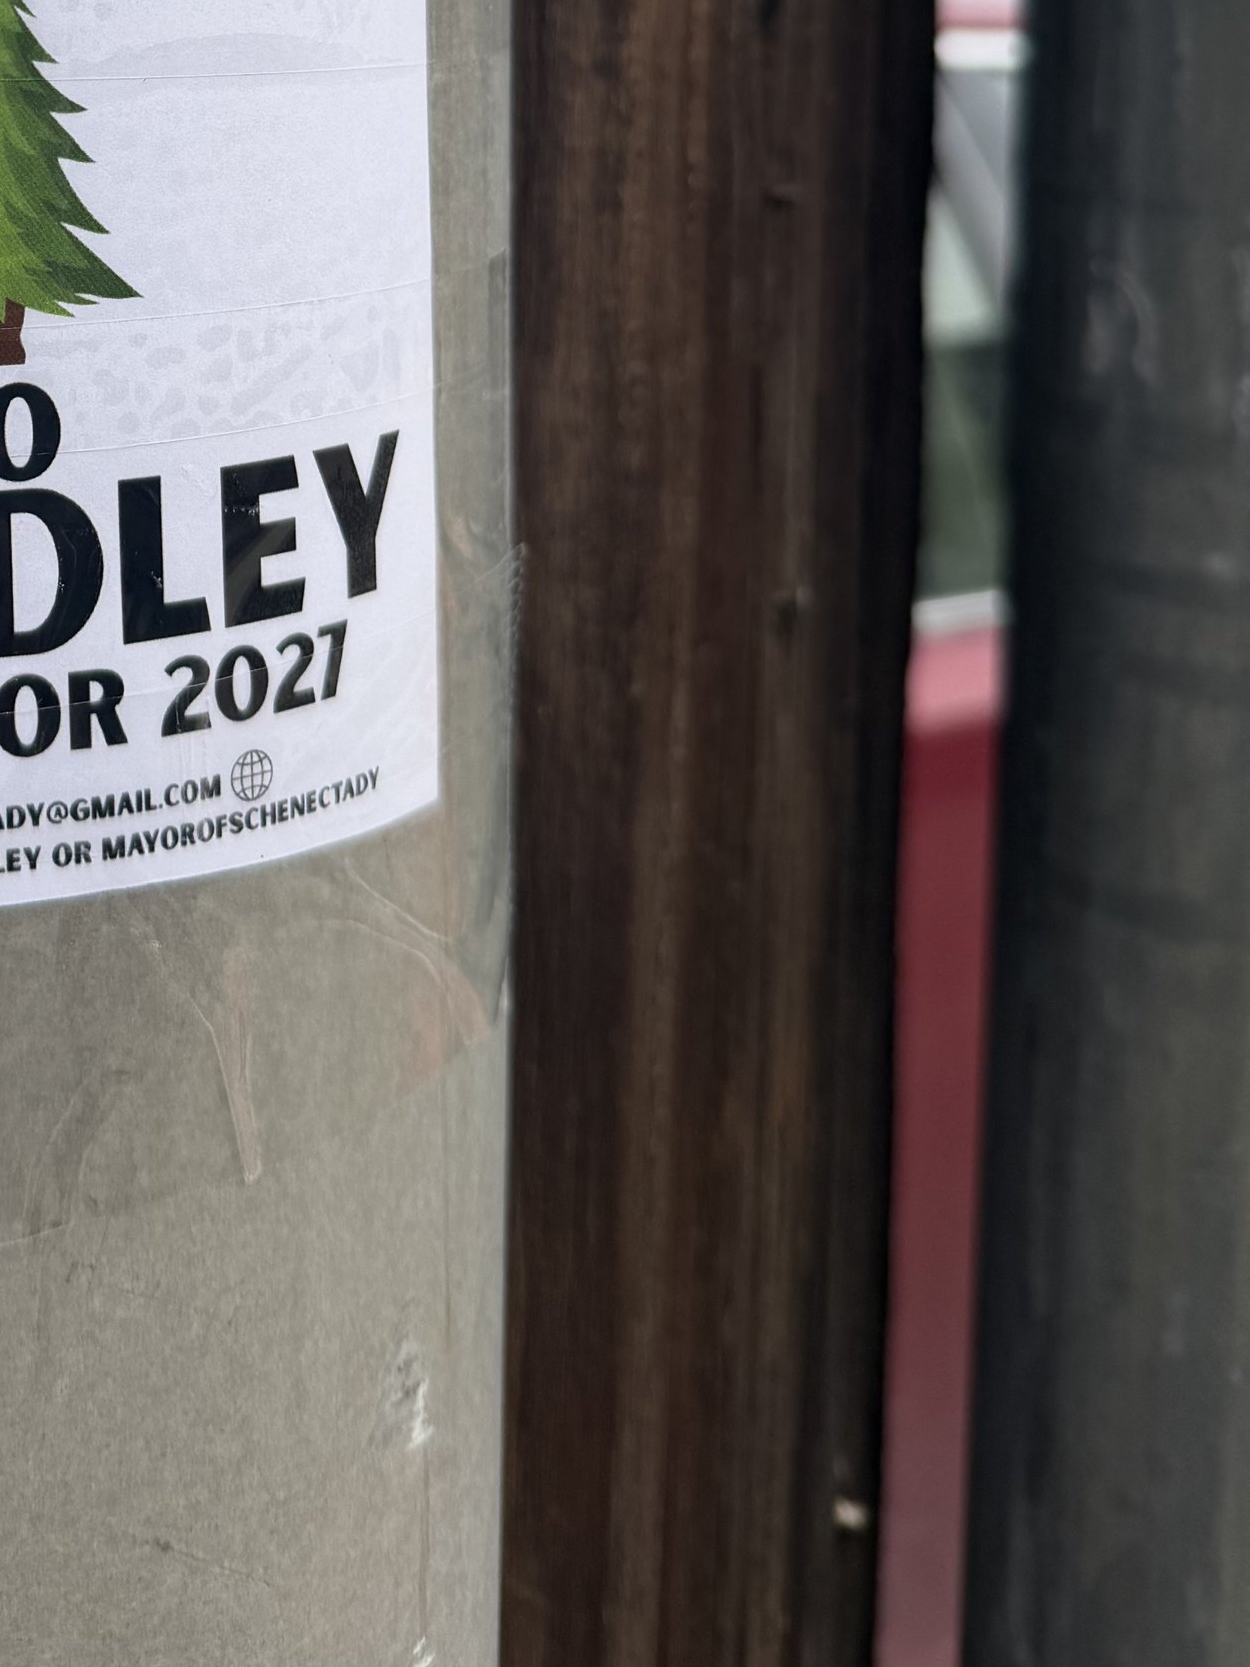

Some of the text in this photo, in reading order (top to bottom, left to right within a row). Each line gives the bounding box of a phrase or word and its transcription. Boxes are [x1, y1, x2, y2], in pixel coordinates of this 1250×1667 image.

[161, 620, 348, 738] 2027
[52, 841, 92, 867] OR
[102, 766, 380, 861] MAYOROFSCHENECTADY
